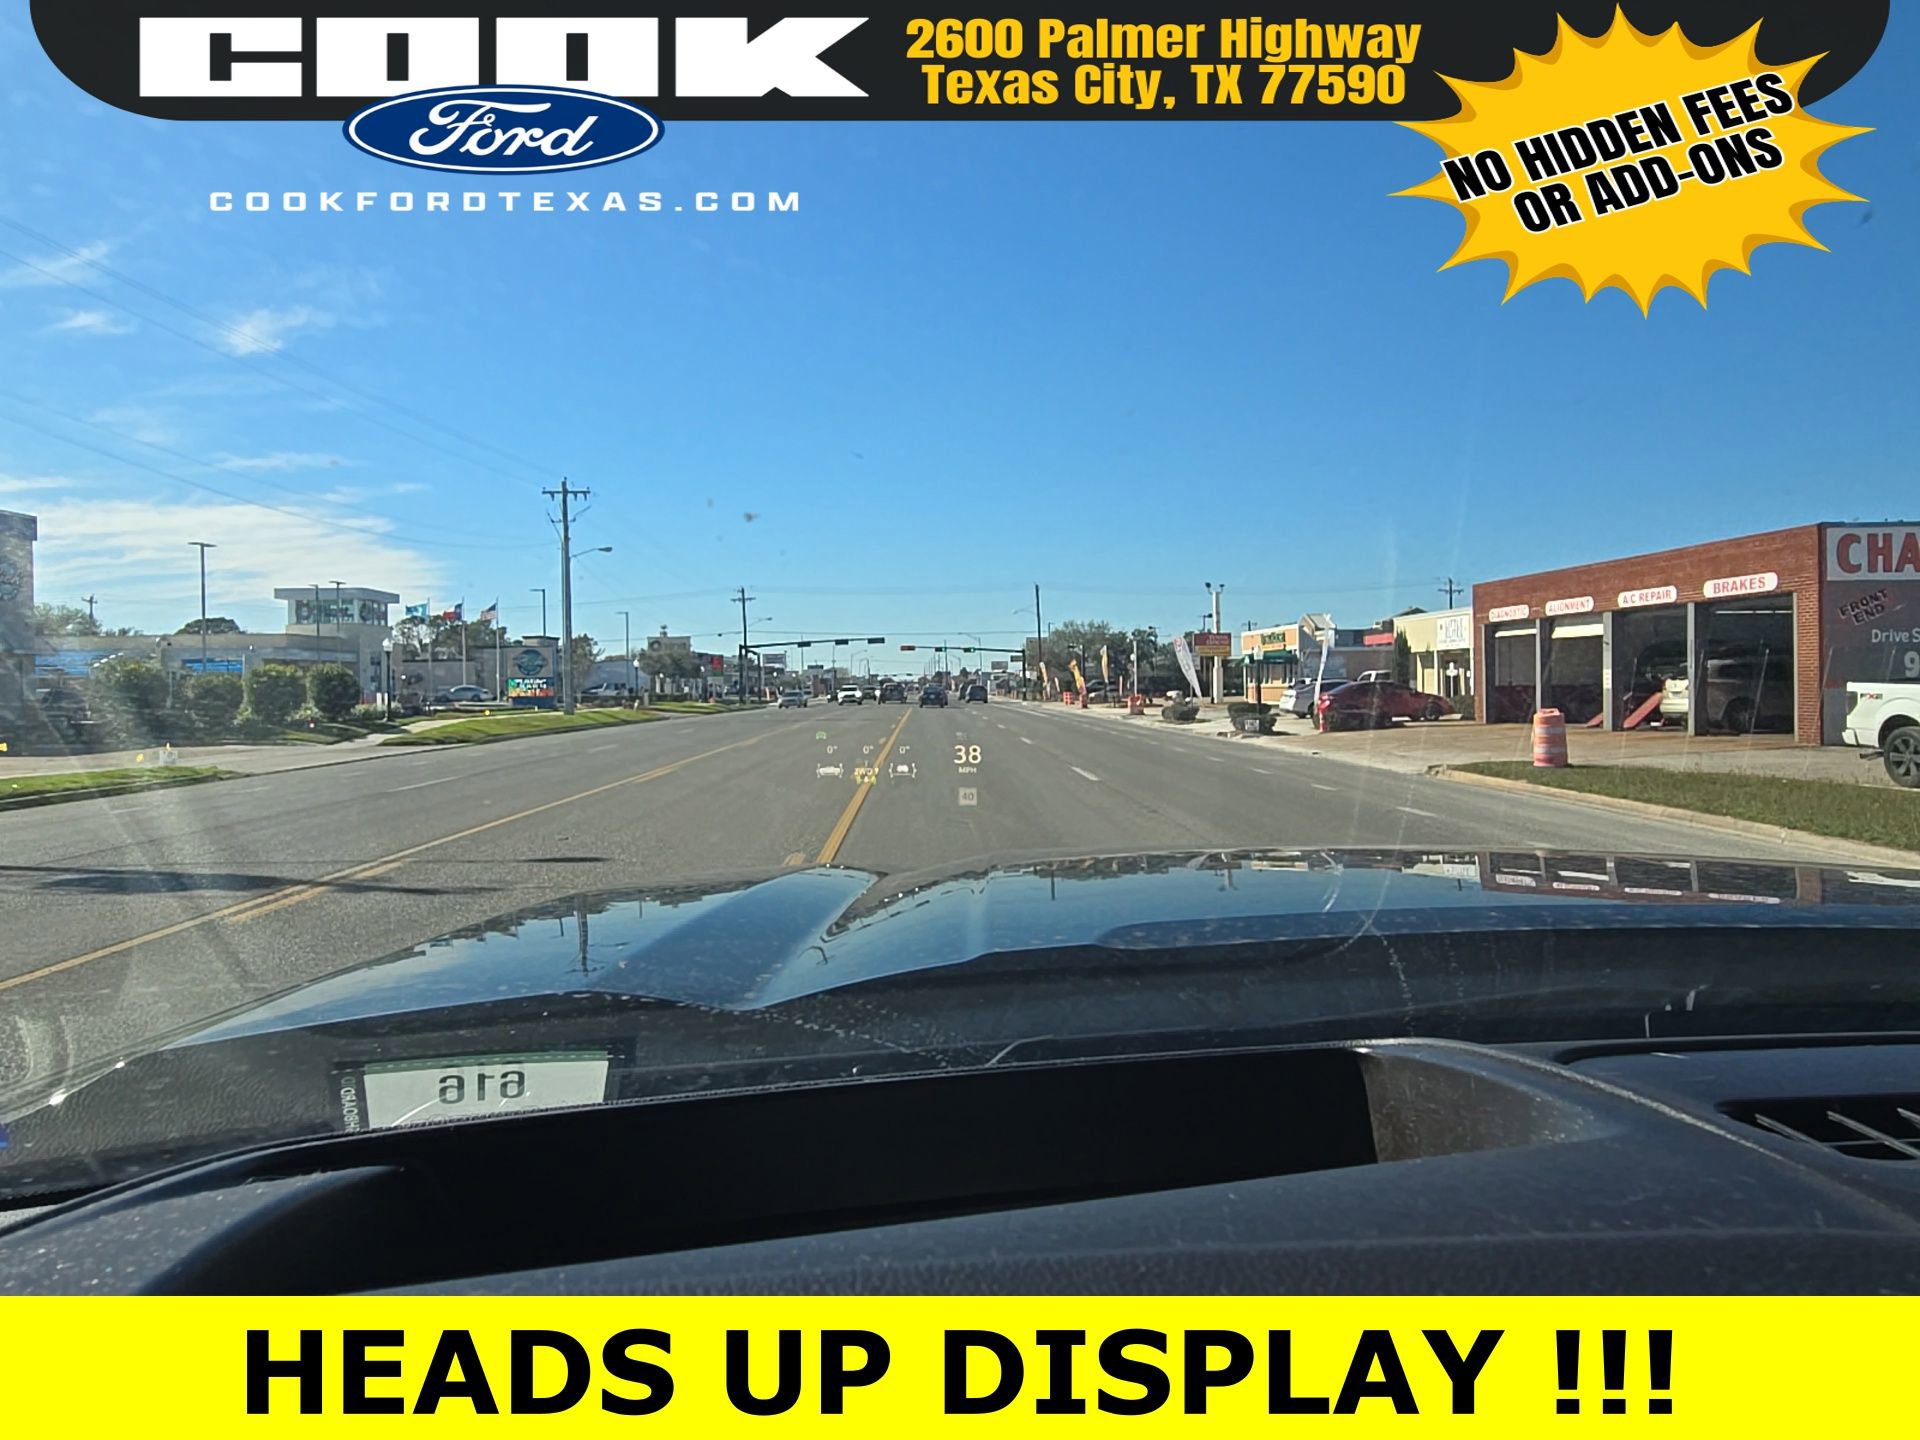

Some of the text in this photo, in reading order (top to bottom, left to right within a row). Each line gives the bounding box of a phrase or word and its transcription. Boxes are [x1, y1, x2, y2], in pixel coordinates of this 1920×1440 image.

[1712, 576, 1767, 596] BRAKES
[1638, 589, 1672, 603] REPAIR
[1839, 588, 1889, 618] FRONT
[1548, 598, 1590, 614] ALIGNMENT
[1852, 604, 1886, 625] END
[1871, 628, 1910, 644] Drive
[953, 744, 982, 764] 38
[958, 766, 977, 774] MPH
